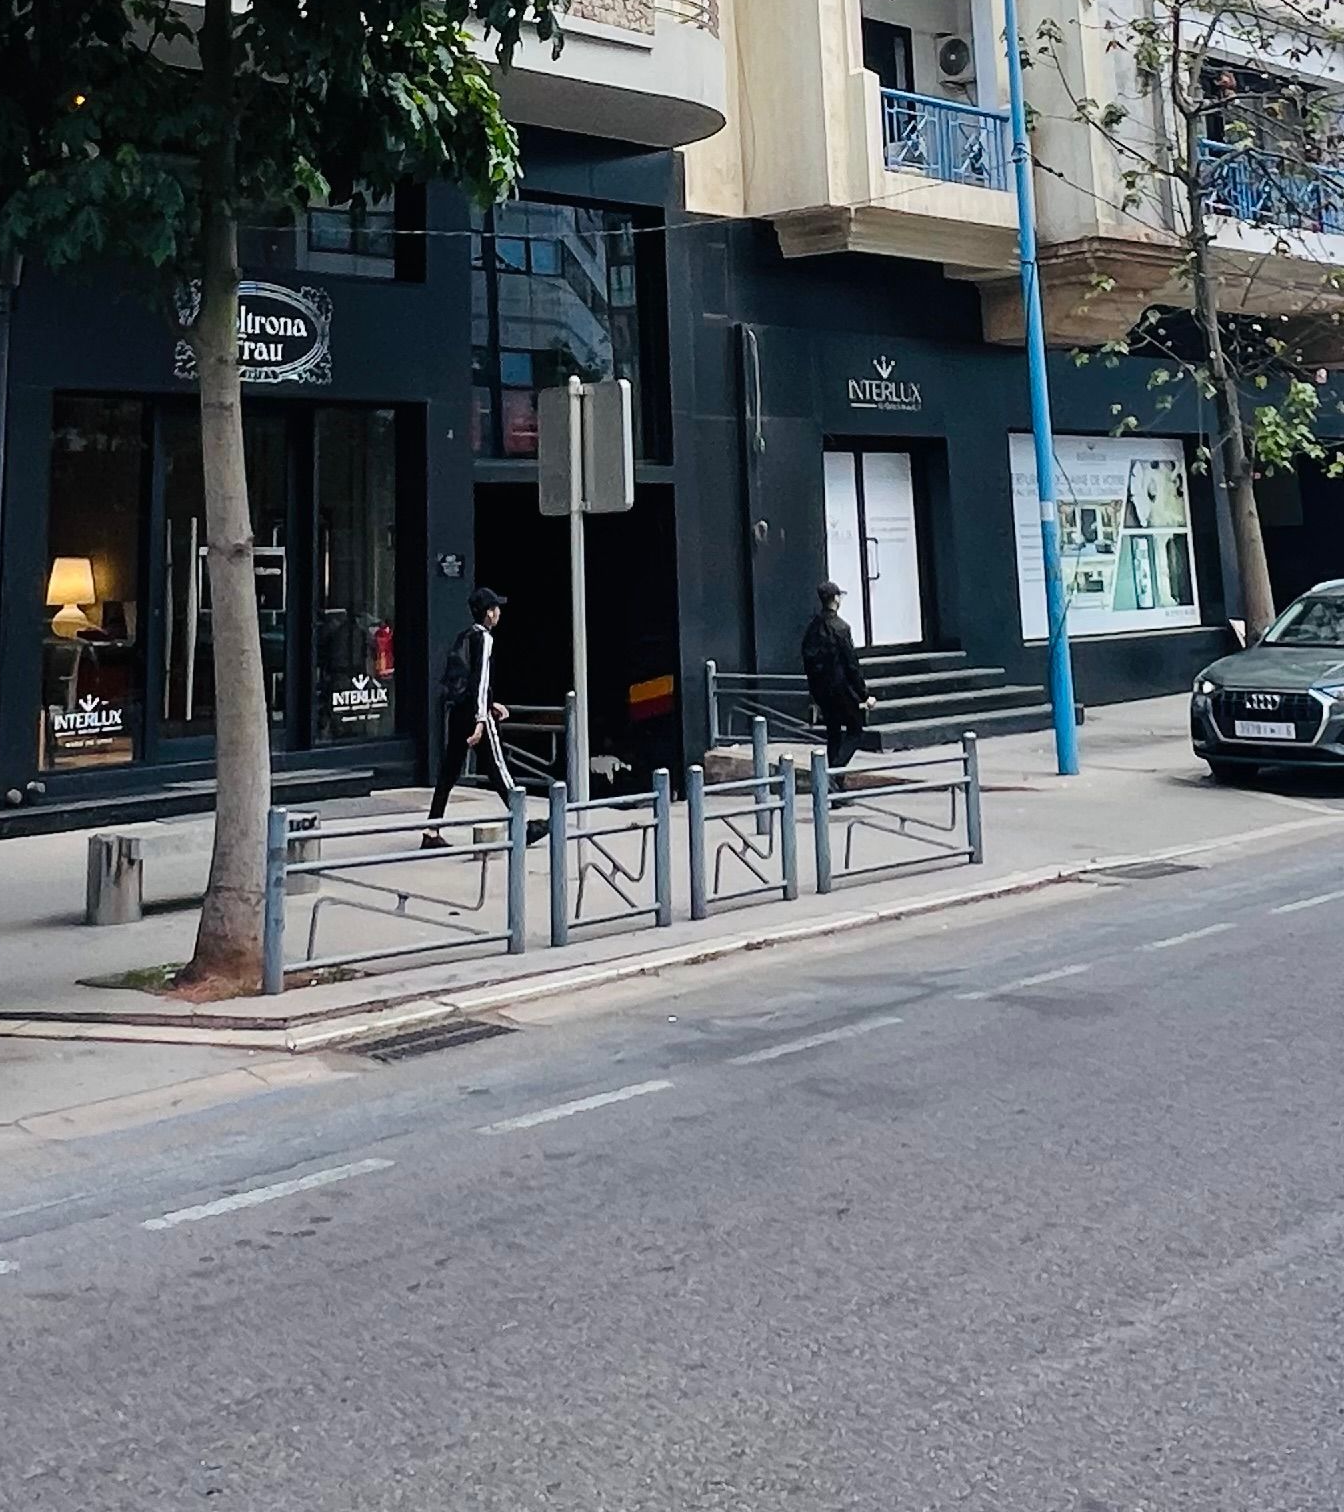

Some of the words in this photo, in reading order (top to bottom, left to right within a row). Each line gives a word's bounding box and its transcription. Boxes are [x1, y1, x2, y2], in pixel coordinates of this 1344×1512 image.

[236, 305, 308, 337] ltrona
[848, 379, 922, 403] INTERLUX
[54, 708, 122, 731] INTERLUX
